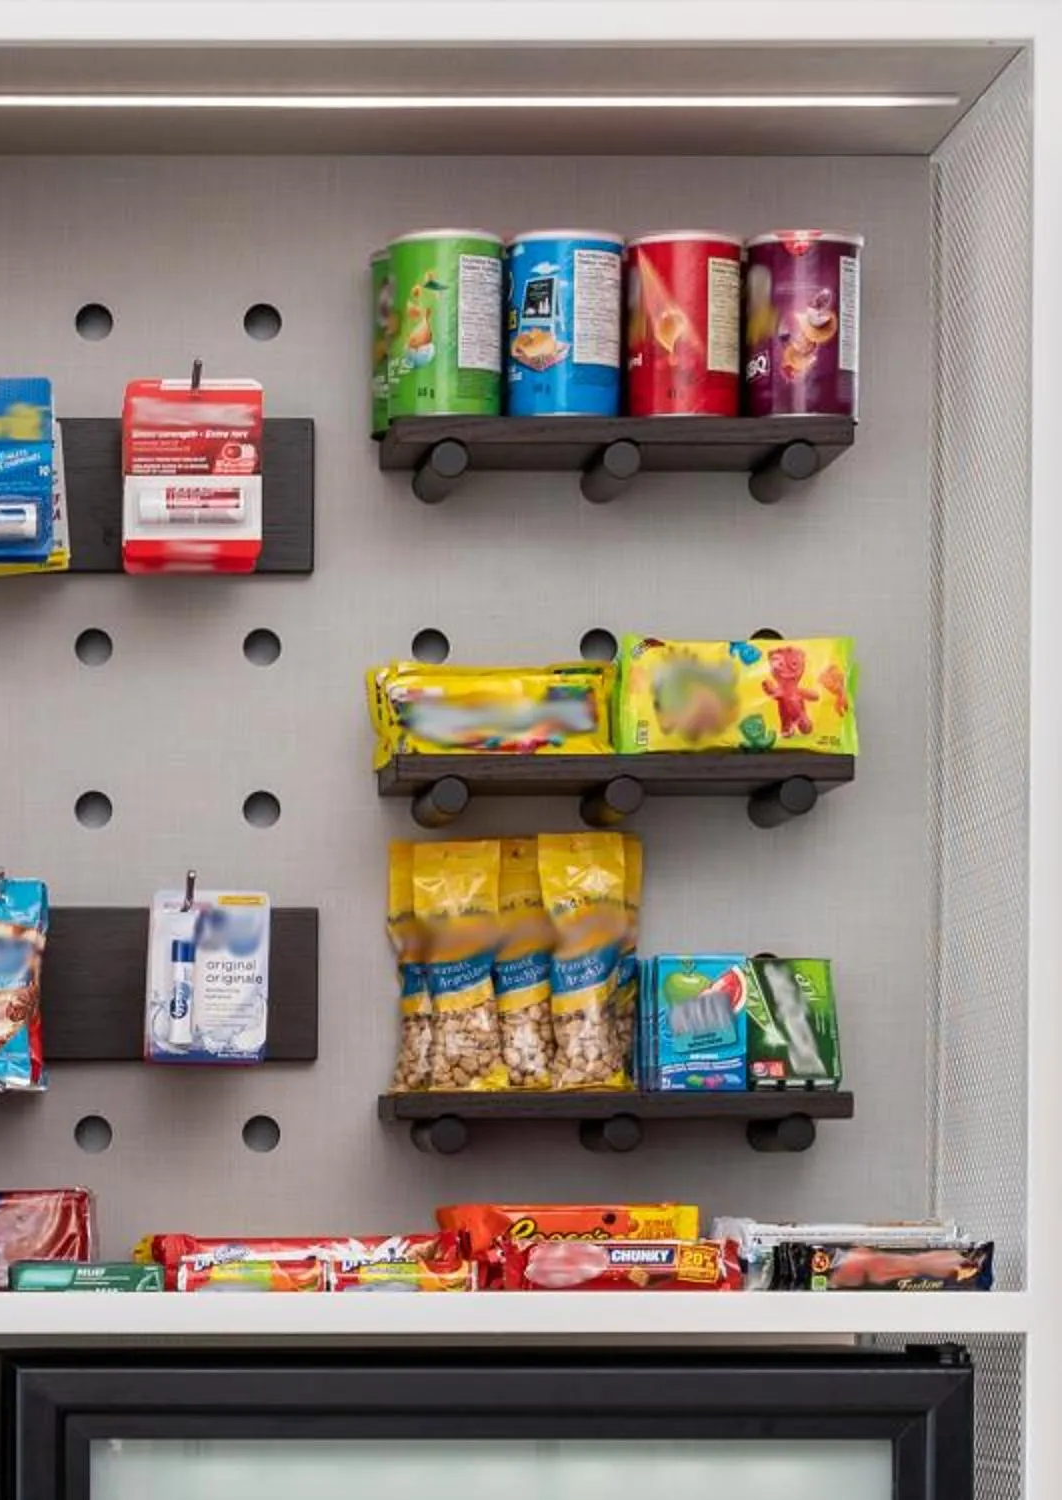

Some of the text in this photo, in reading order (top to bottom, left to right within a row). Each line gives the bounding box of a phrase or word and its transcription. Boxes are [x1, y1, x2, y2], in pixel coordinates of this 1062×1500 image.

[206, 959, 257, 973] original
[205, 975, 263, 989] originale
[611, 1250, 670, 1263] CHUNKY
